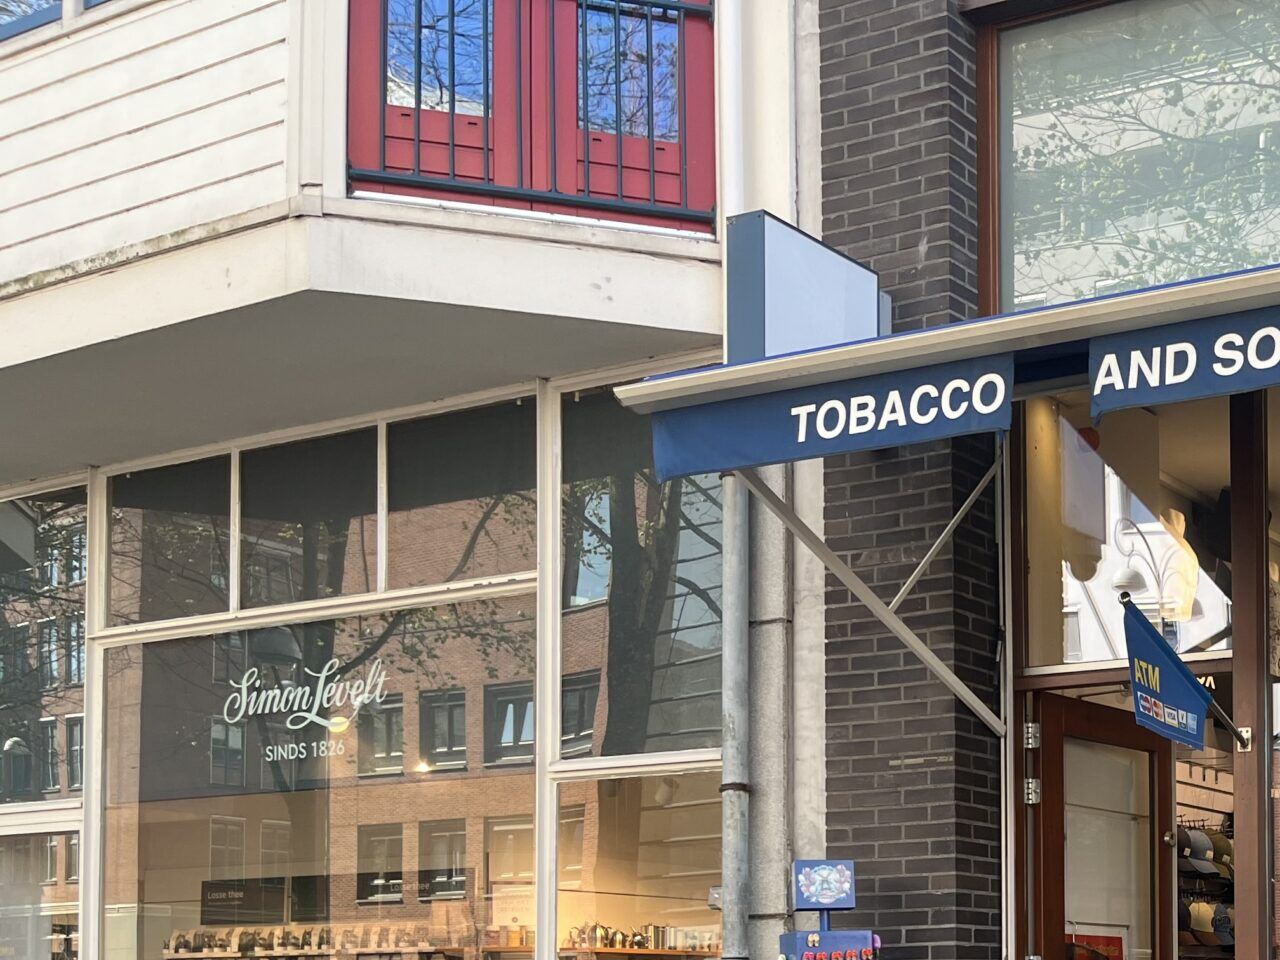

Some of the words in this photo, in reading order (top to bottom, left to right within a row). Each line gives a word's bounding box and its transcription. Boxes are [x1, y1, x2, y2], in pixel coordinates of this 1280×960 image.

[790, 373, 1006, 443] TOBACCO
[1092, 342, 1197, 395] AND
[224, 667, 313, 723] Simon
[286, 658, 391, 729] Lévelt
[1134, 658, 1160, 693] ATM
[265, 743, 307, 761] SINDS
[311, 740, 345, 758] 1826
